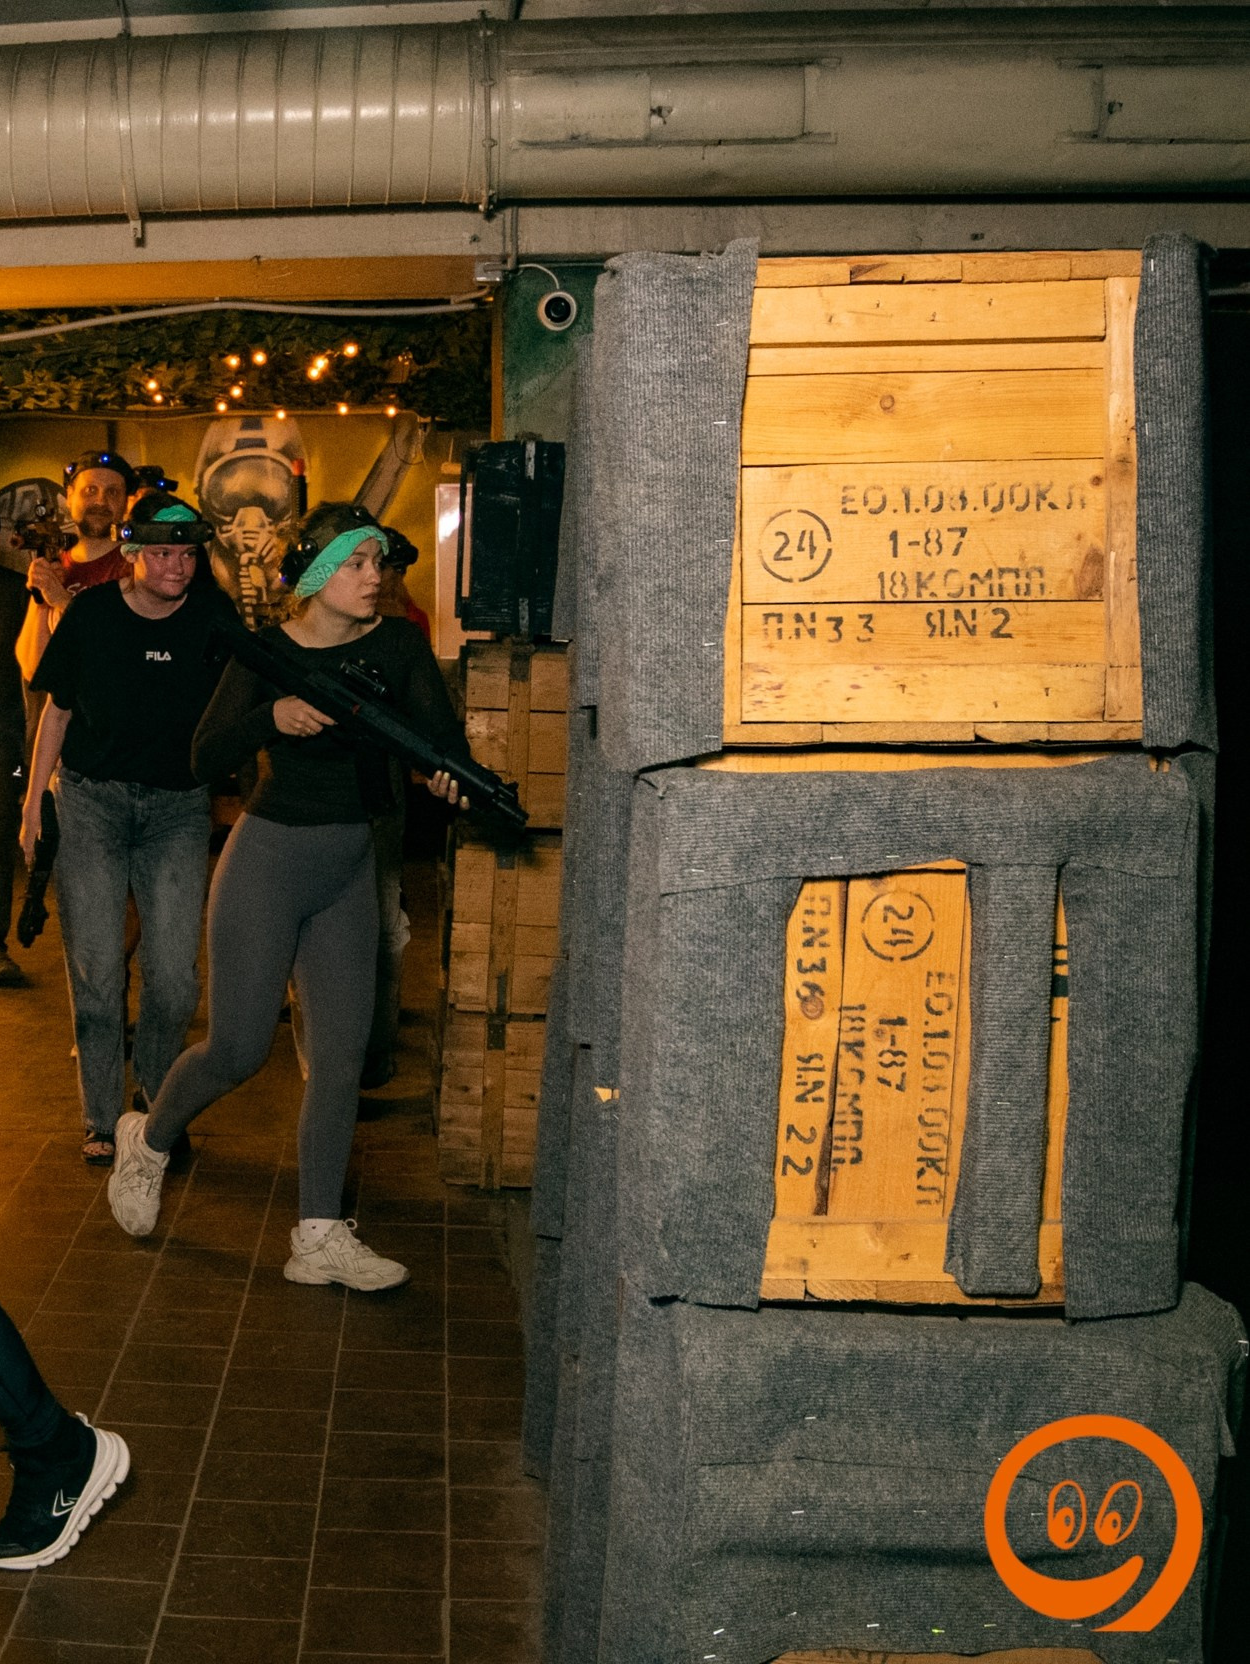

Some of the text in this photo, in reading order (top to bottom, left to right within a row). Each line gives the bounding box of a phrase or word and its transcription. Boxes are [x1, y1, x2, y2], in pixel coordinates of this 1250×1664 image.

[772, 529, 818, 562] 24
[888, 526, 969, 558] 1-87
[145, 650, 172, 661] FILA
[882, 904, 915, 948] 24
[876, 1015, 909, 1093] 1-87
[781, 1122, 818, 1178] 22
